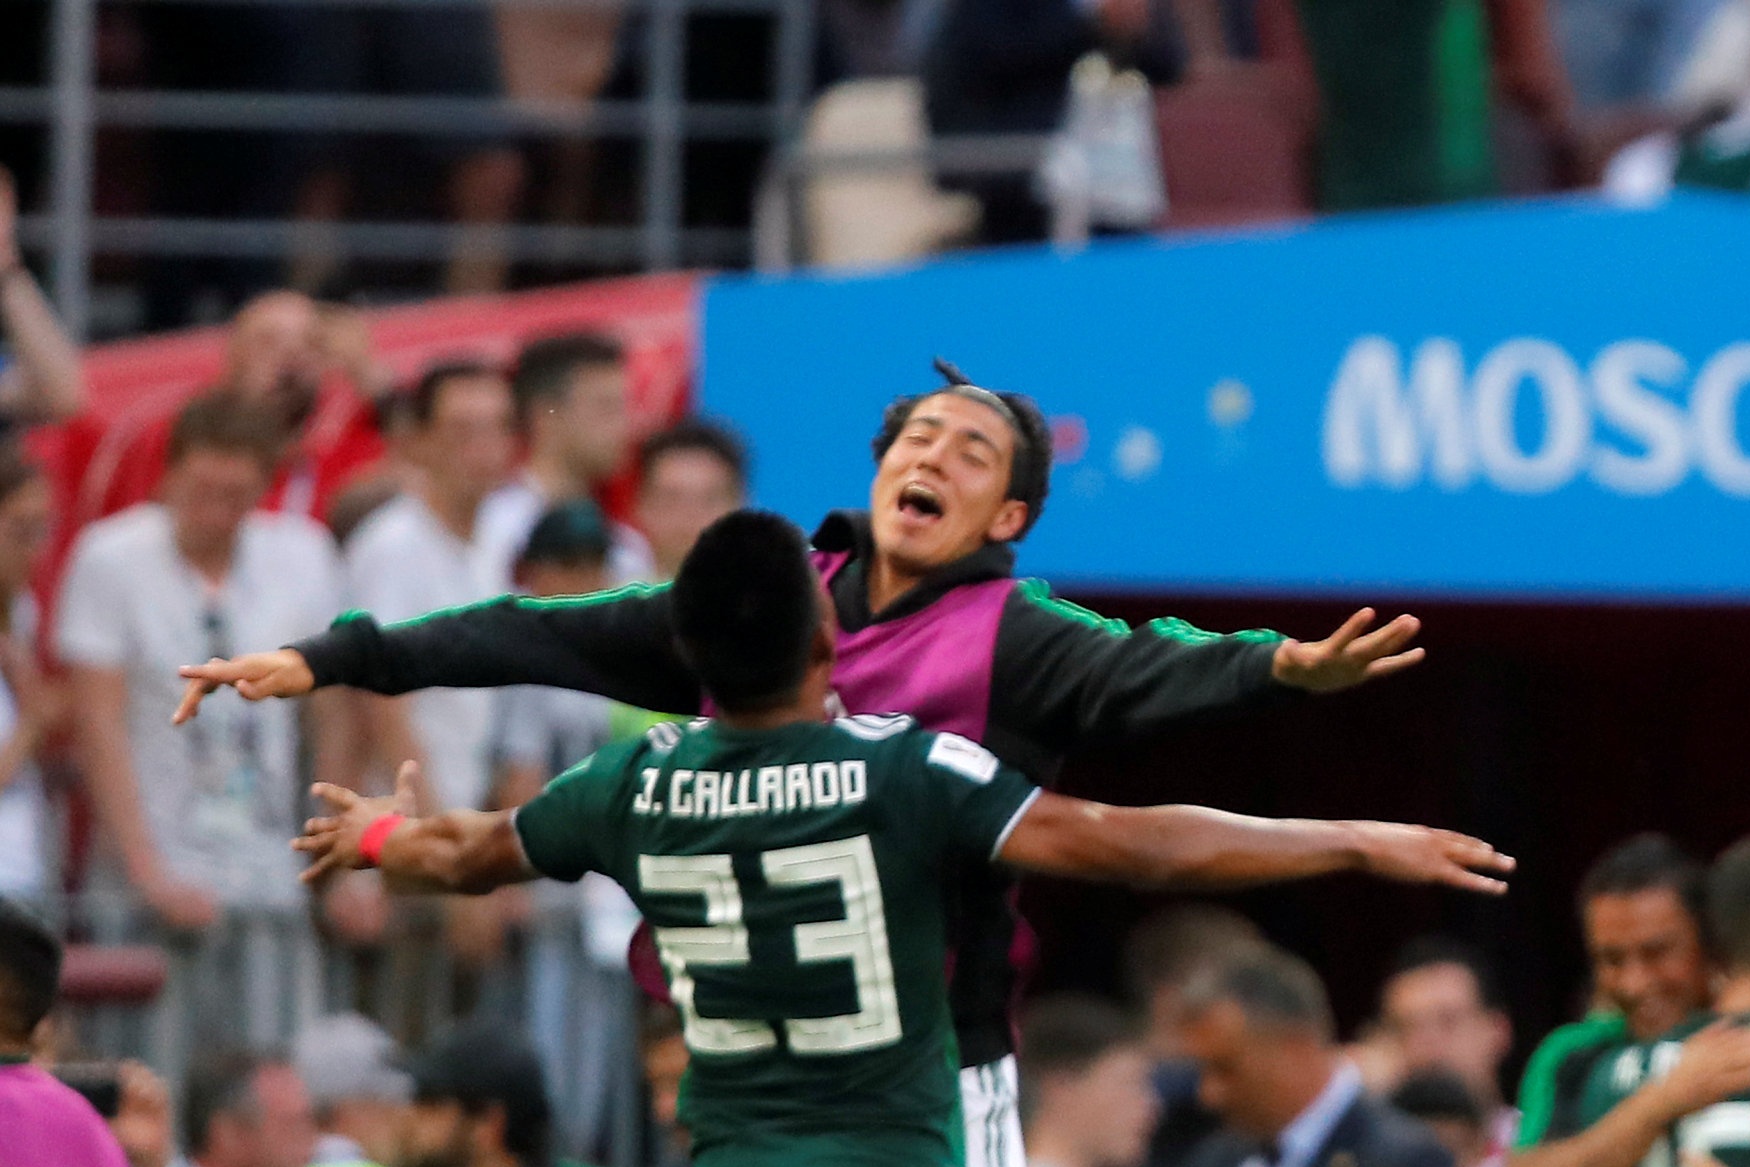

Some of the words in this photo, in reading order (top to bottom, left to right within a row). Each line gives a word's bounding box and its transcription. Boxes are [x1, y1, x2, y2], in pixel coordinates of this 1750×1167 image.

[633, 767, 664, 815] J.
[669, 759, 868, 818] GALLARDO
[638, 834, 903, 1055] 23
